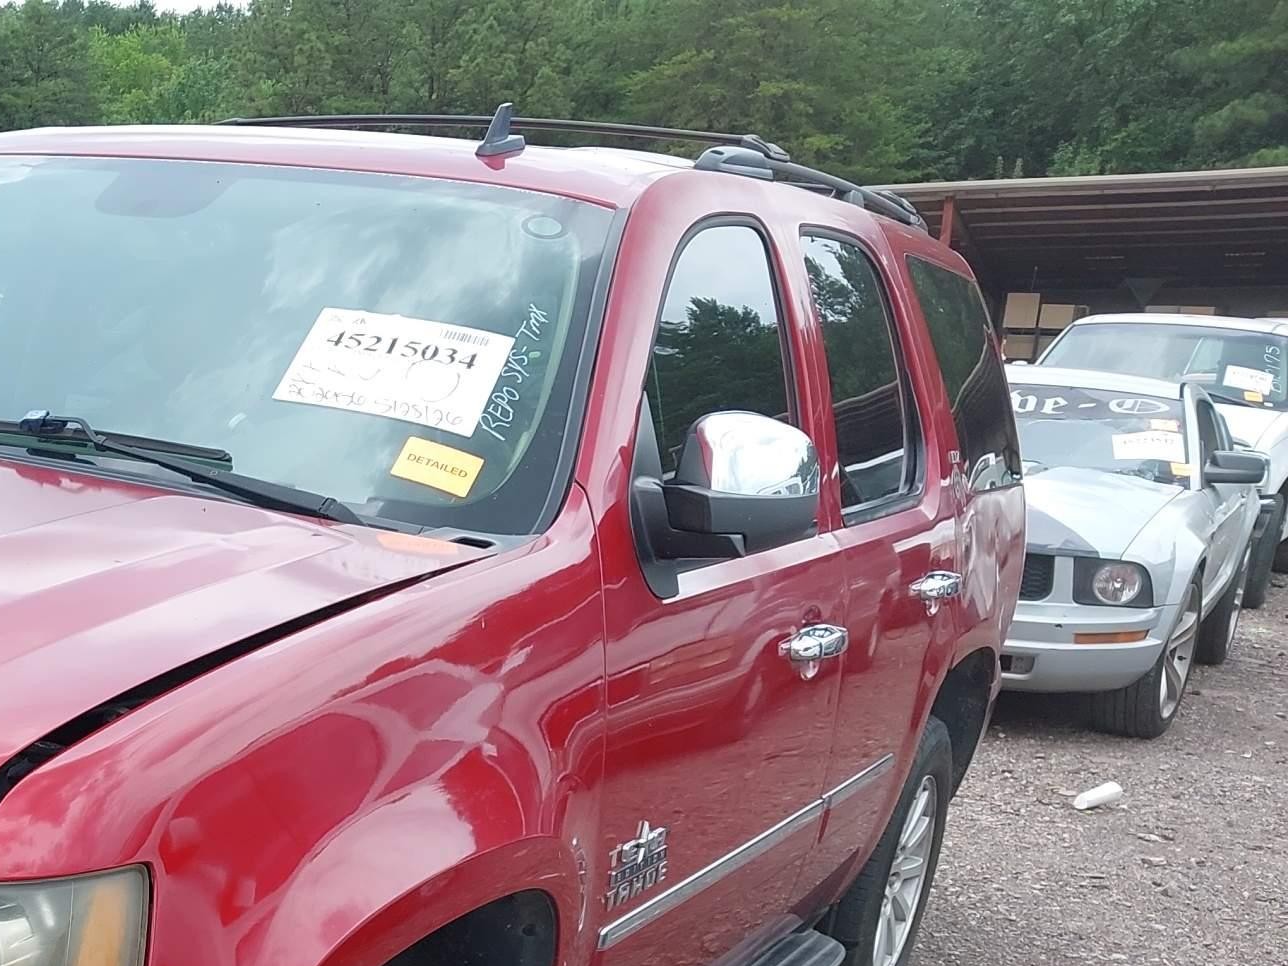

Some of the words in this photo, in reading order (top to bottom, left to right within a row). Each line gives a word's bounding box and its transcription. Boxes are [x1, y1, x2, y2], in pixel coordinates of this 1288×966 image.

[327, 331, 478, 369] 45215034
[480, 387, 519, 440] REPO
[407, 453, 469, 478] DETAILED
